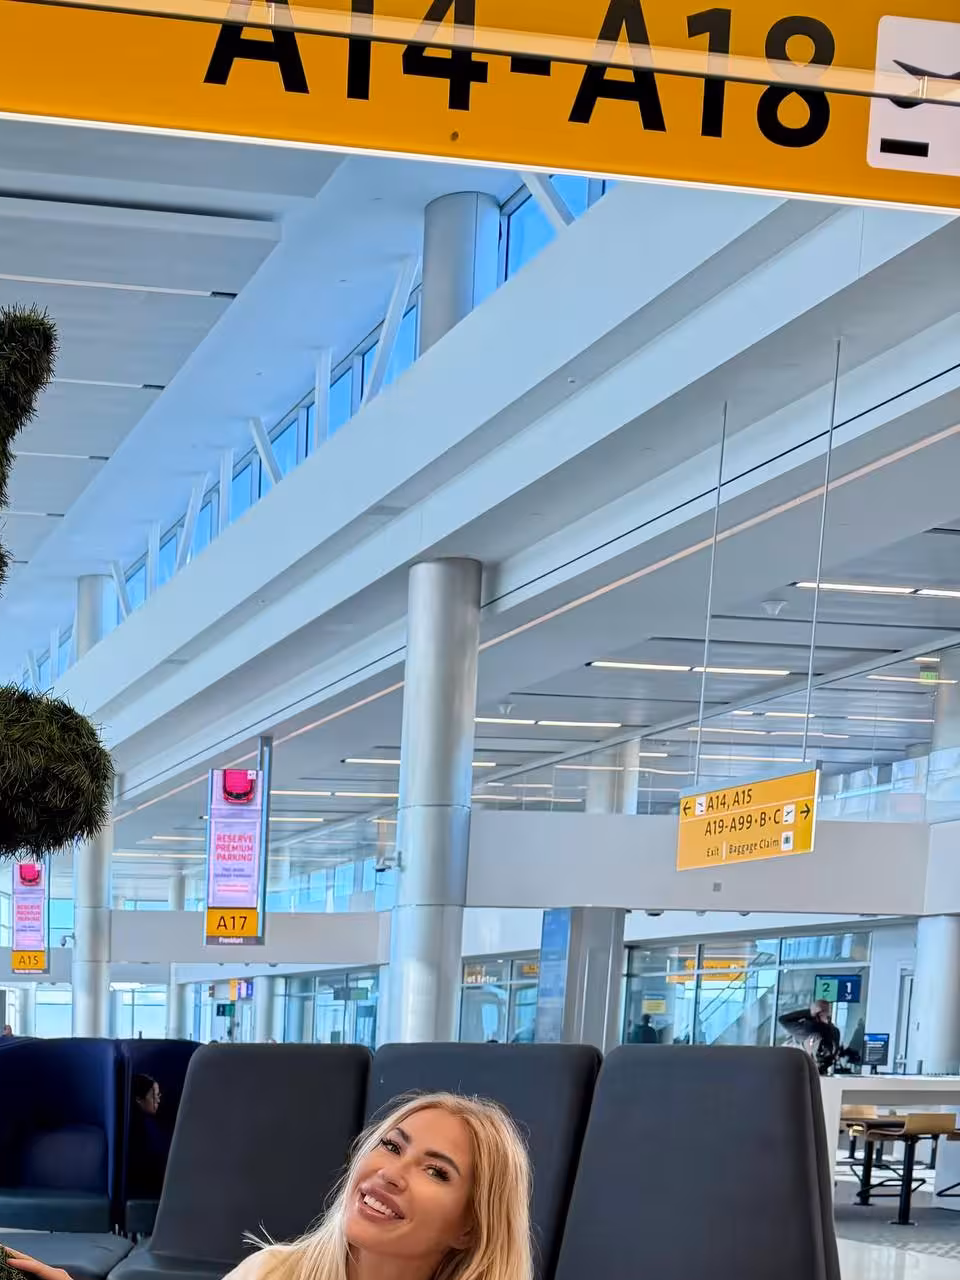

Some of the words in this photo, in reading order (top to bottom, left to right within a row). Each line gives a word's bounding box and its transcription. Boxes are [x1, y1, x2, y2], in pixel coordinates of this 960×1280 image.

[203, 0, 836, 148] A14-A18
[732, 788, 753, 806] A15
[216, 834, 253, 843] RESERVE
[215, 844, 254, 852] PREMIUM
[706, 847, 720, 858] Exit
[728, 840, 758, 855] Baggage
[758, 837, 780, 849] Claim
[216, 853, 253, 862] PARKING
[216, 915, 248, 931] A17
[18, 955, 39, 966] A15
[822, 982, 830, 993] 2
[845, 982, 852, 993] 1
